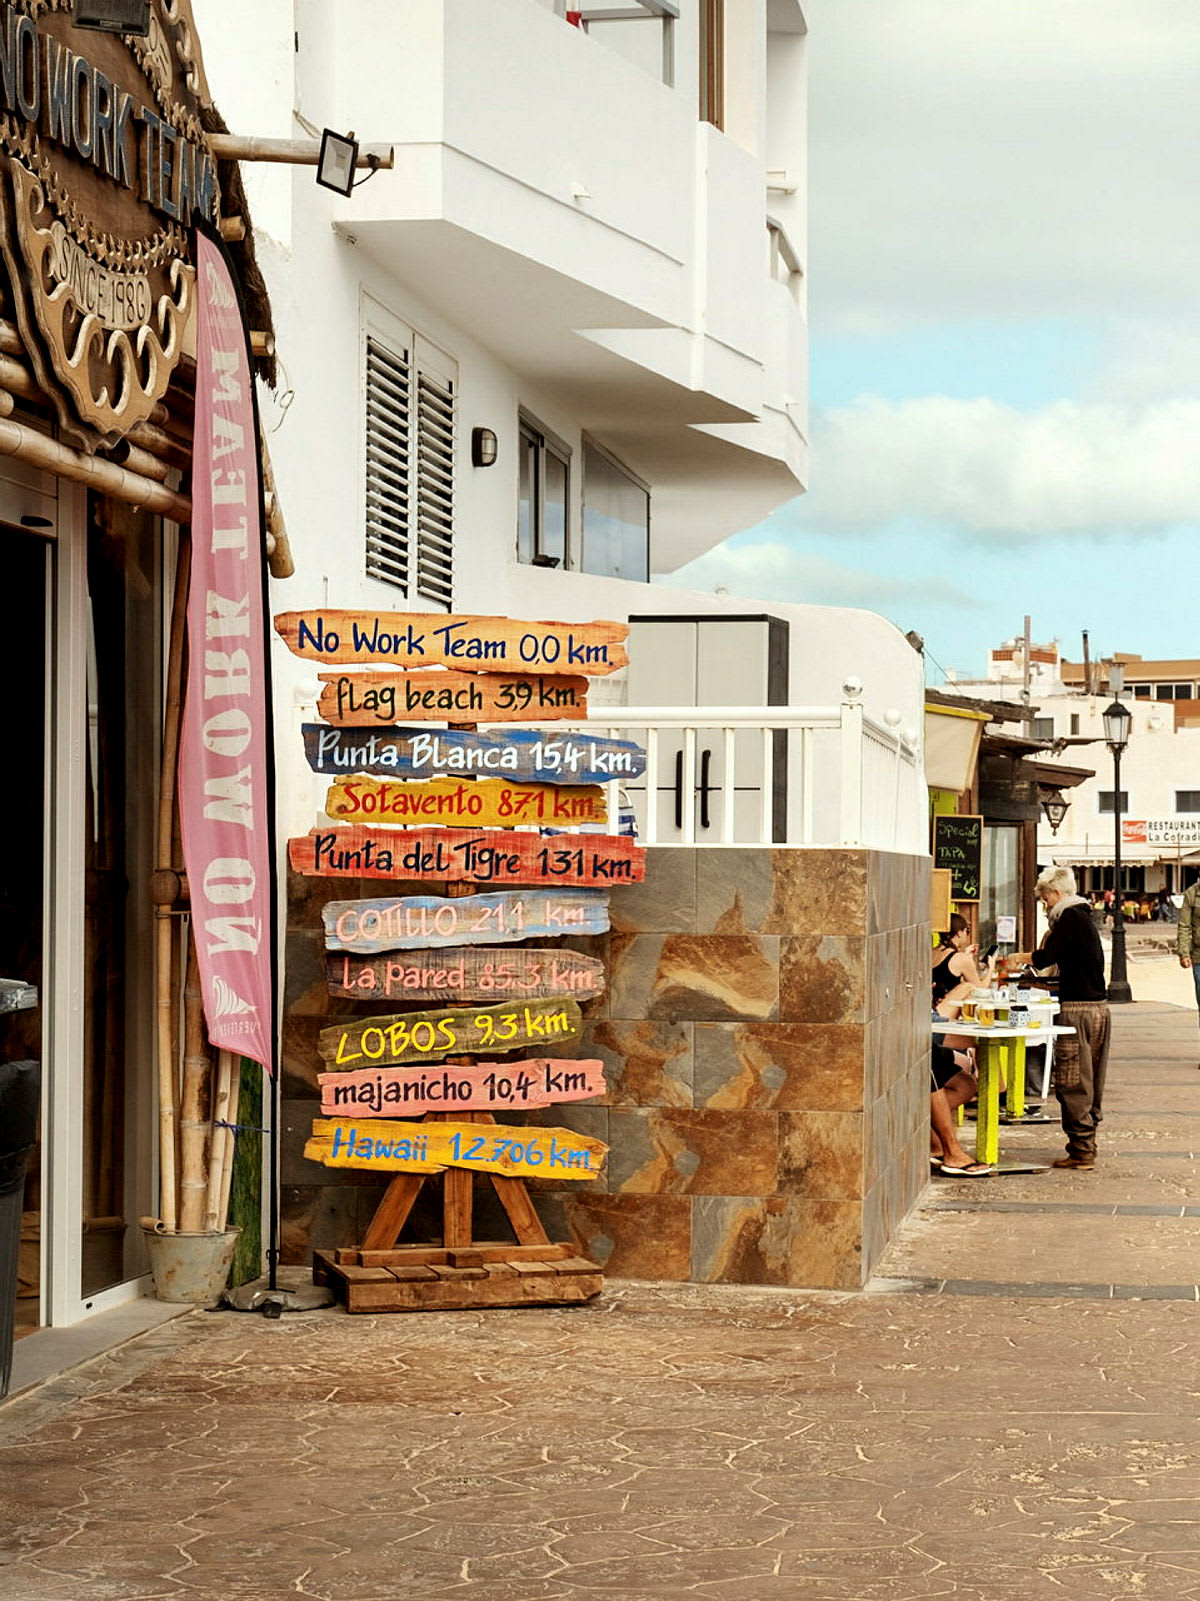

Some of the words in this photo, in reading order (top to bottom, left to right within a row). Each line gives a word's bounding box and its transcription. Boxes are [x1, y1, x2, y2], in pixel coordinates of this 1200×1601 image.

[47, 34, 132, 190] WORK
[141, 105, 215, 232] TEAM
[59, 237, 106, 321] SINCE
[298, 617, 339, 653] No
[352, 618, 425, 655] Work
[433, 621, 506, 659] Team
[519, 634, 560, 665] 0,0
[568, 634, 615, 666] km.
[338, 676, 396, 720] flag
[406, 679, 483, 712] beach
[494, 681, 533, 711] 3,9
[538, 678, 581, 707] km.
[316, 730, 399, 768] Punta
[407, 733, 518, 769] Blanca
[529, 741, 585, 775] 15,4
[590, 741, 638, 773] km.
[341, 782, 482, 815] Sotavento
[497, 788, 545, 819] 87,1
[553, 787, 600, 819] km.
[314, 835, 393, 871] Punta
[403, 841, 450, 872] del
[453, 838, 521, 880] Tigre
[537, 847, 584, 876] 131
[592, 854, 637, 880] km.
[1149, 832, 1160, 841] La
[470, 900, 524, 936] 21,1
[550, 960, 598, 990] km.
[335, 1017, 456, 1064] LOBOS
[474, 1013, 517, 1048] 9,3
[524, 1007, 576, 1039] km.
[334, 1073, 473, 1112] majanicho
[482, 1076, 536, 1104] 10,4
[545, 1064, 593, 1094] km.
[332, 1127, 429, 1161] Hawaii
